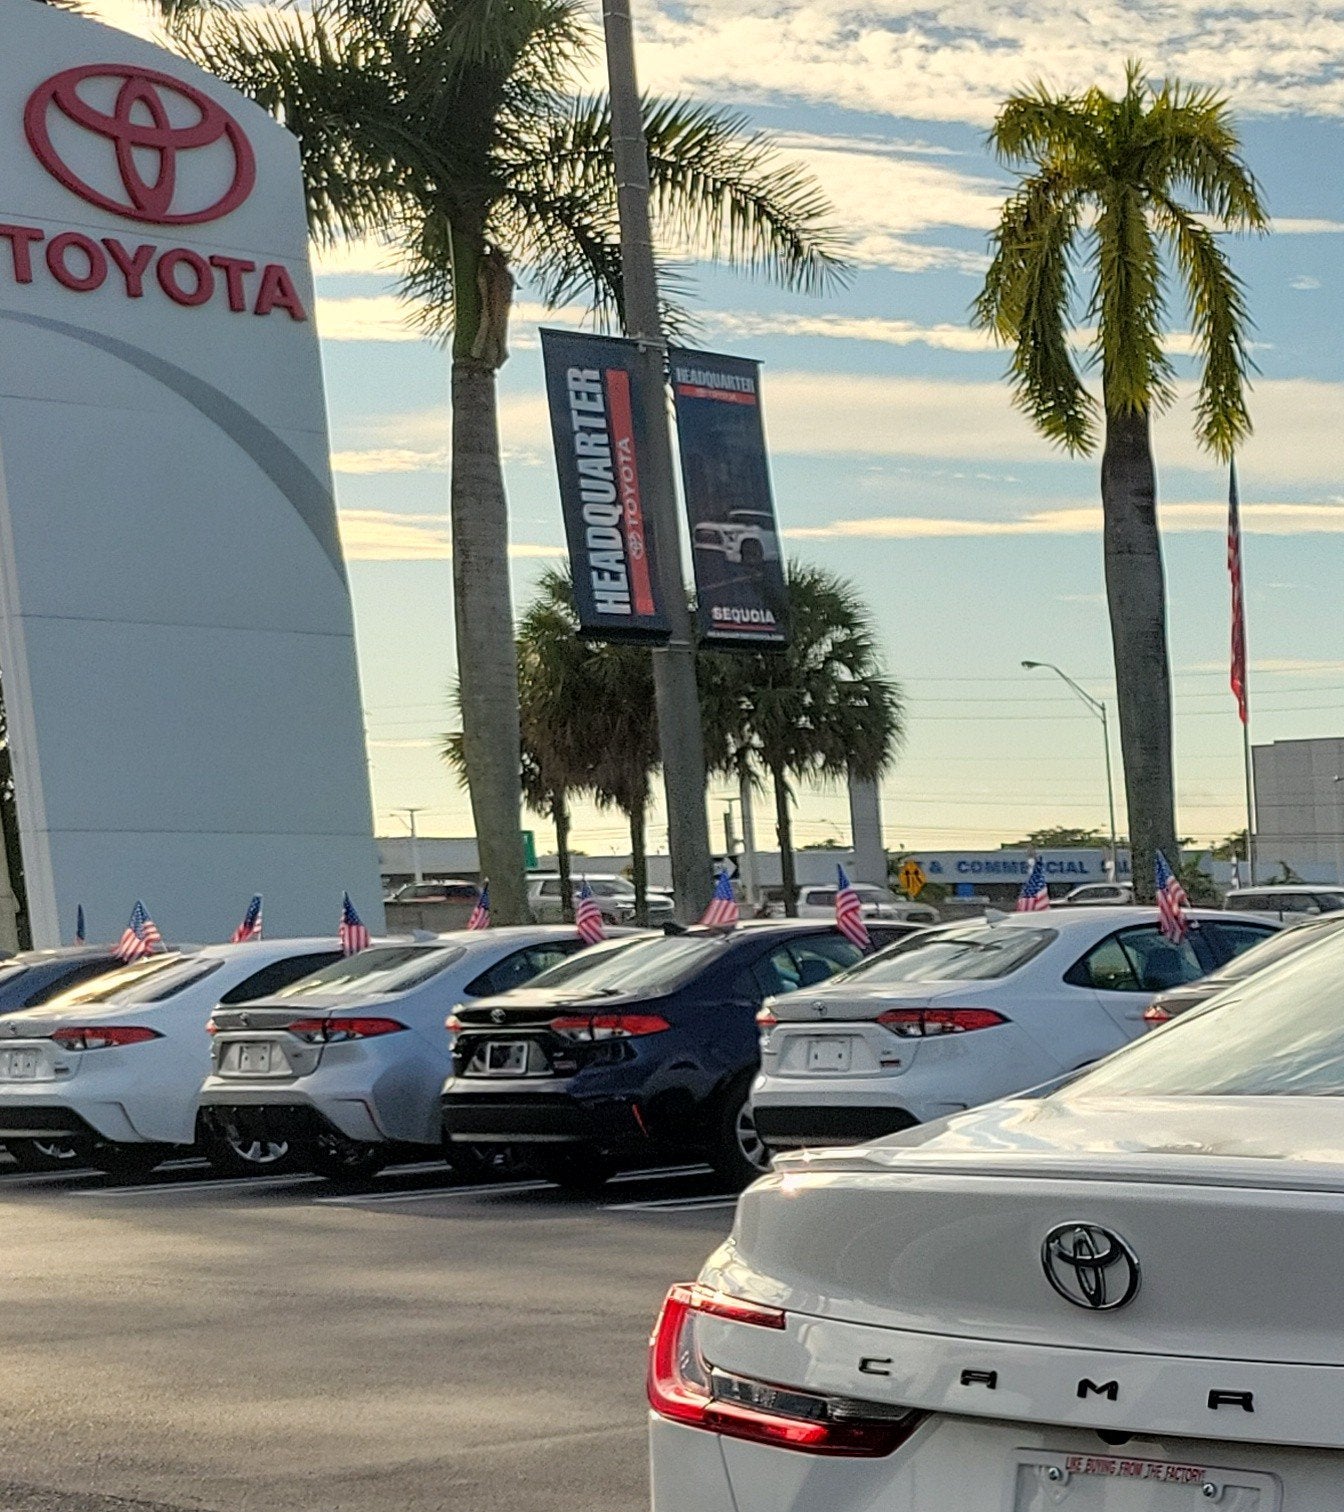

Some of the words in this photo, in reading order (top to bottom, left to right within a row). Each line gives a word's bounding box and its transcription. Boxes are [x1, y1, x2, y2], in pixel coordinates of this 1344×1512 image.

[0, 223, 307, 321] TOYOTA
[566, 366, 632, 615] HEADQUARTER
[616, 437, 639, 527] TOYOTA
[711, 606, 776, 624] SEQUOIA
[957, 861, 1090, 874] COMMECIAL
